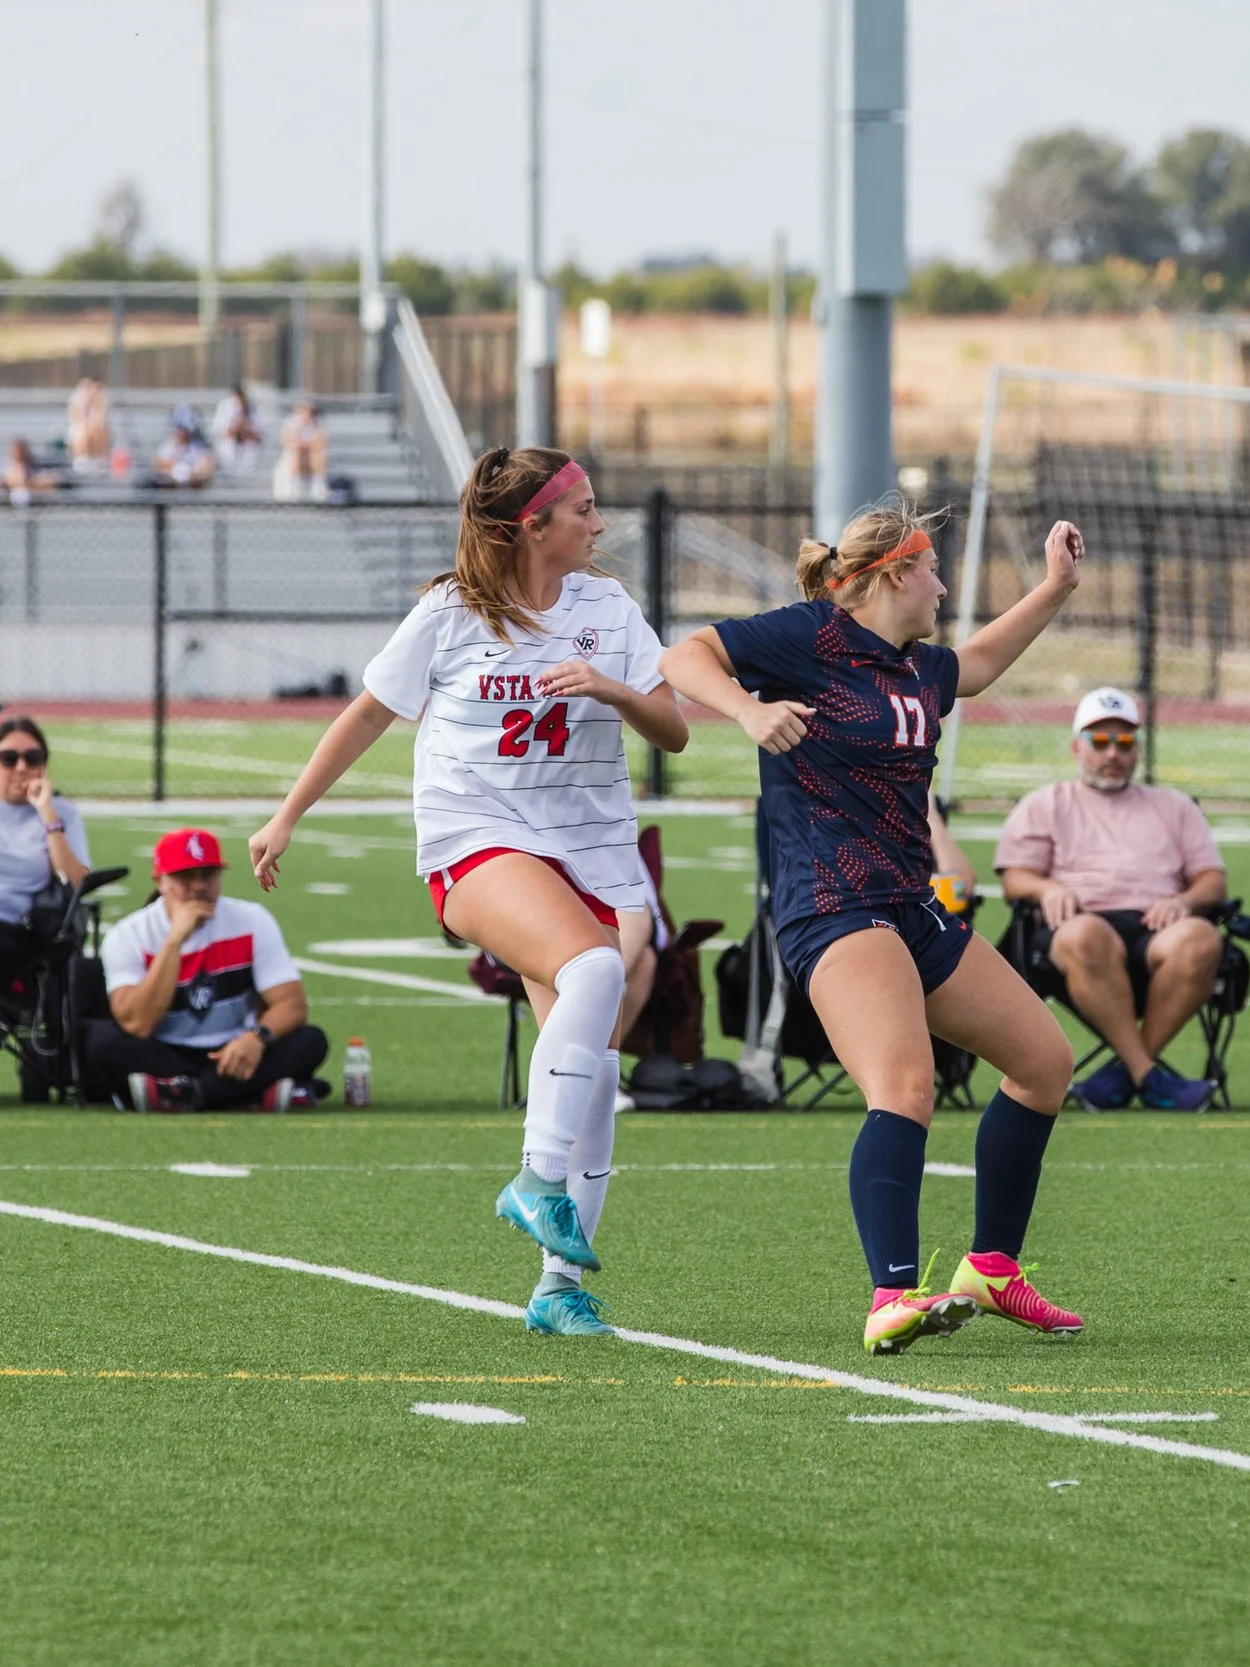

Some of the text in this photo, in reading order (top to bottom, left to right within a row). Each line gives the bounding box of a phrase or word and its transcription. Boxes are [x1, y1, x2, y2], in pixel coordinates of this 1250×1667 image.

[577, 636, 595, 650] VR
[478, 674, 535, 701] VSTA
[497, 702, 570, 758] 24
[888, 693, 926, 747] 17
